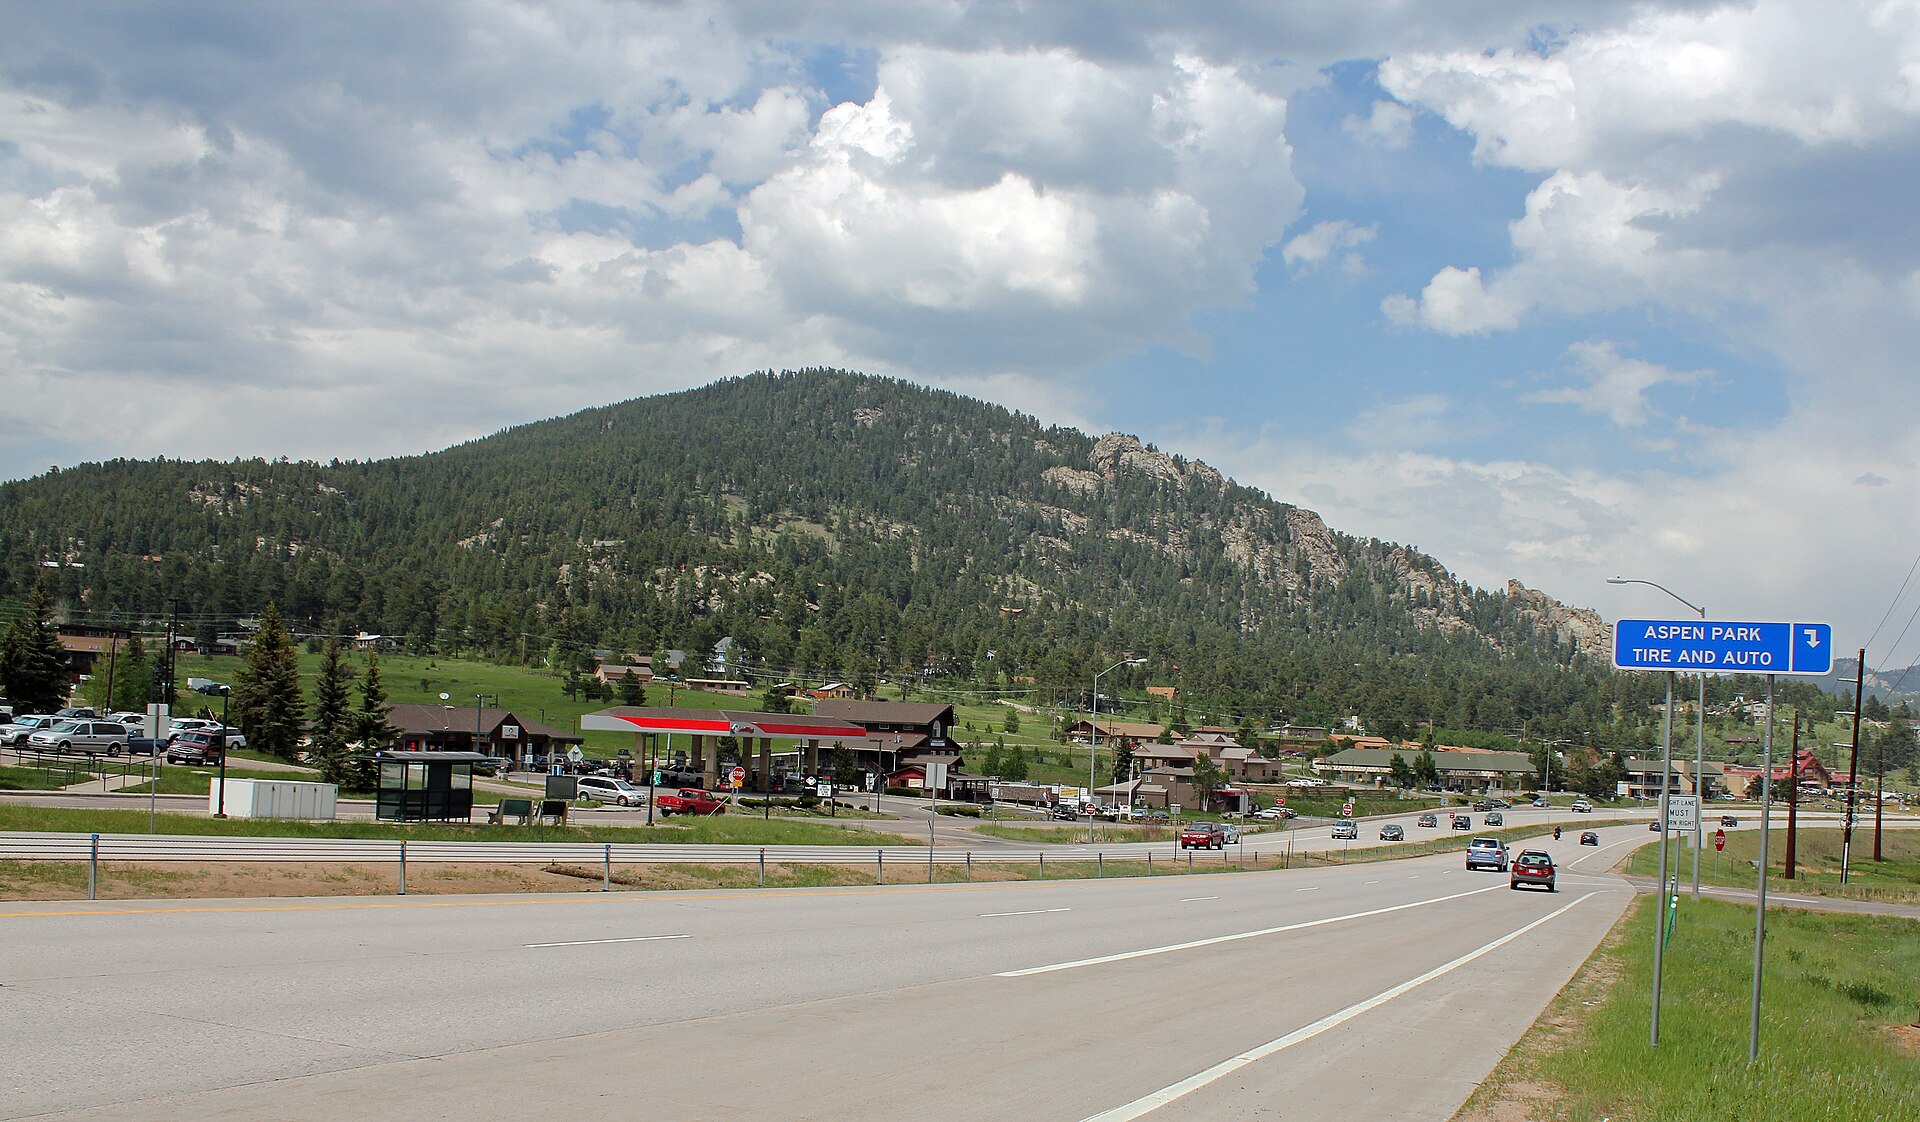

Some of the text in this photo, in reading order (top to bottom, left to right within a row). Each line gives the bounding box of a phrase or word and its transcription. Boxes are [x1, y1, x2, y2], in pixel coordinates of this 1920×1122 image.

[1644, 625, 1761, 641] ASPEN PARK
[1632, 648, 1772, 666] TIRE AND AUTO
